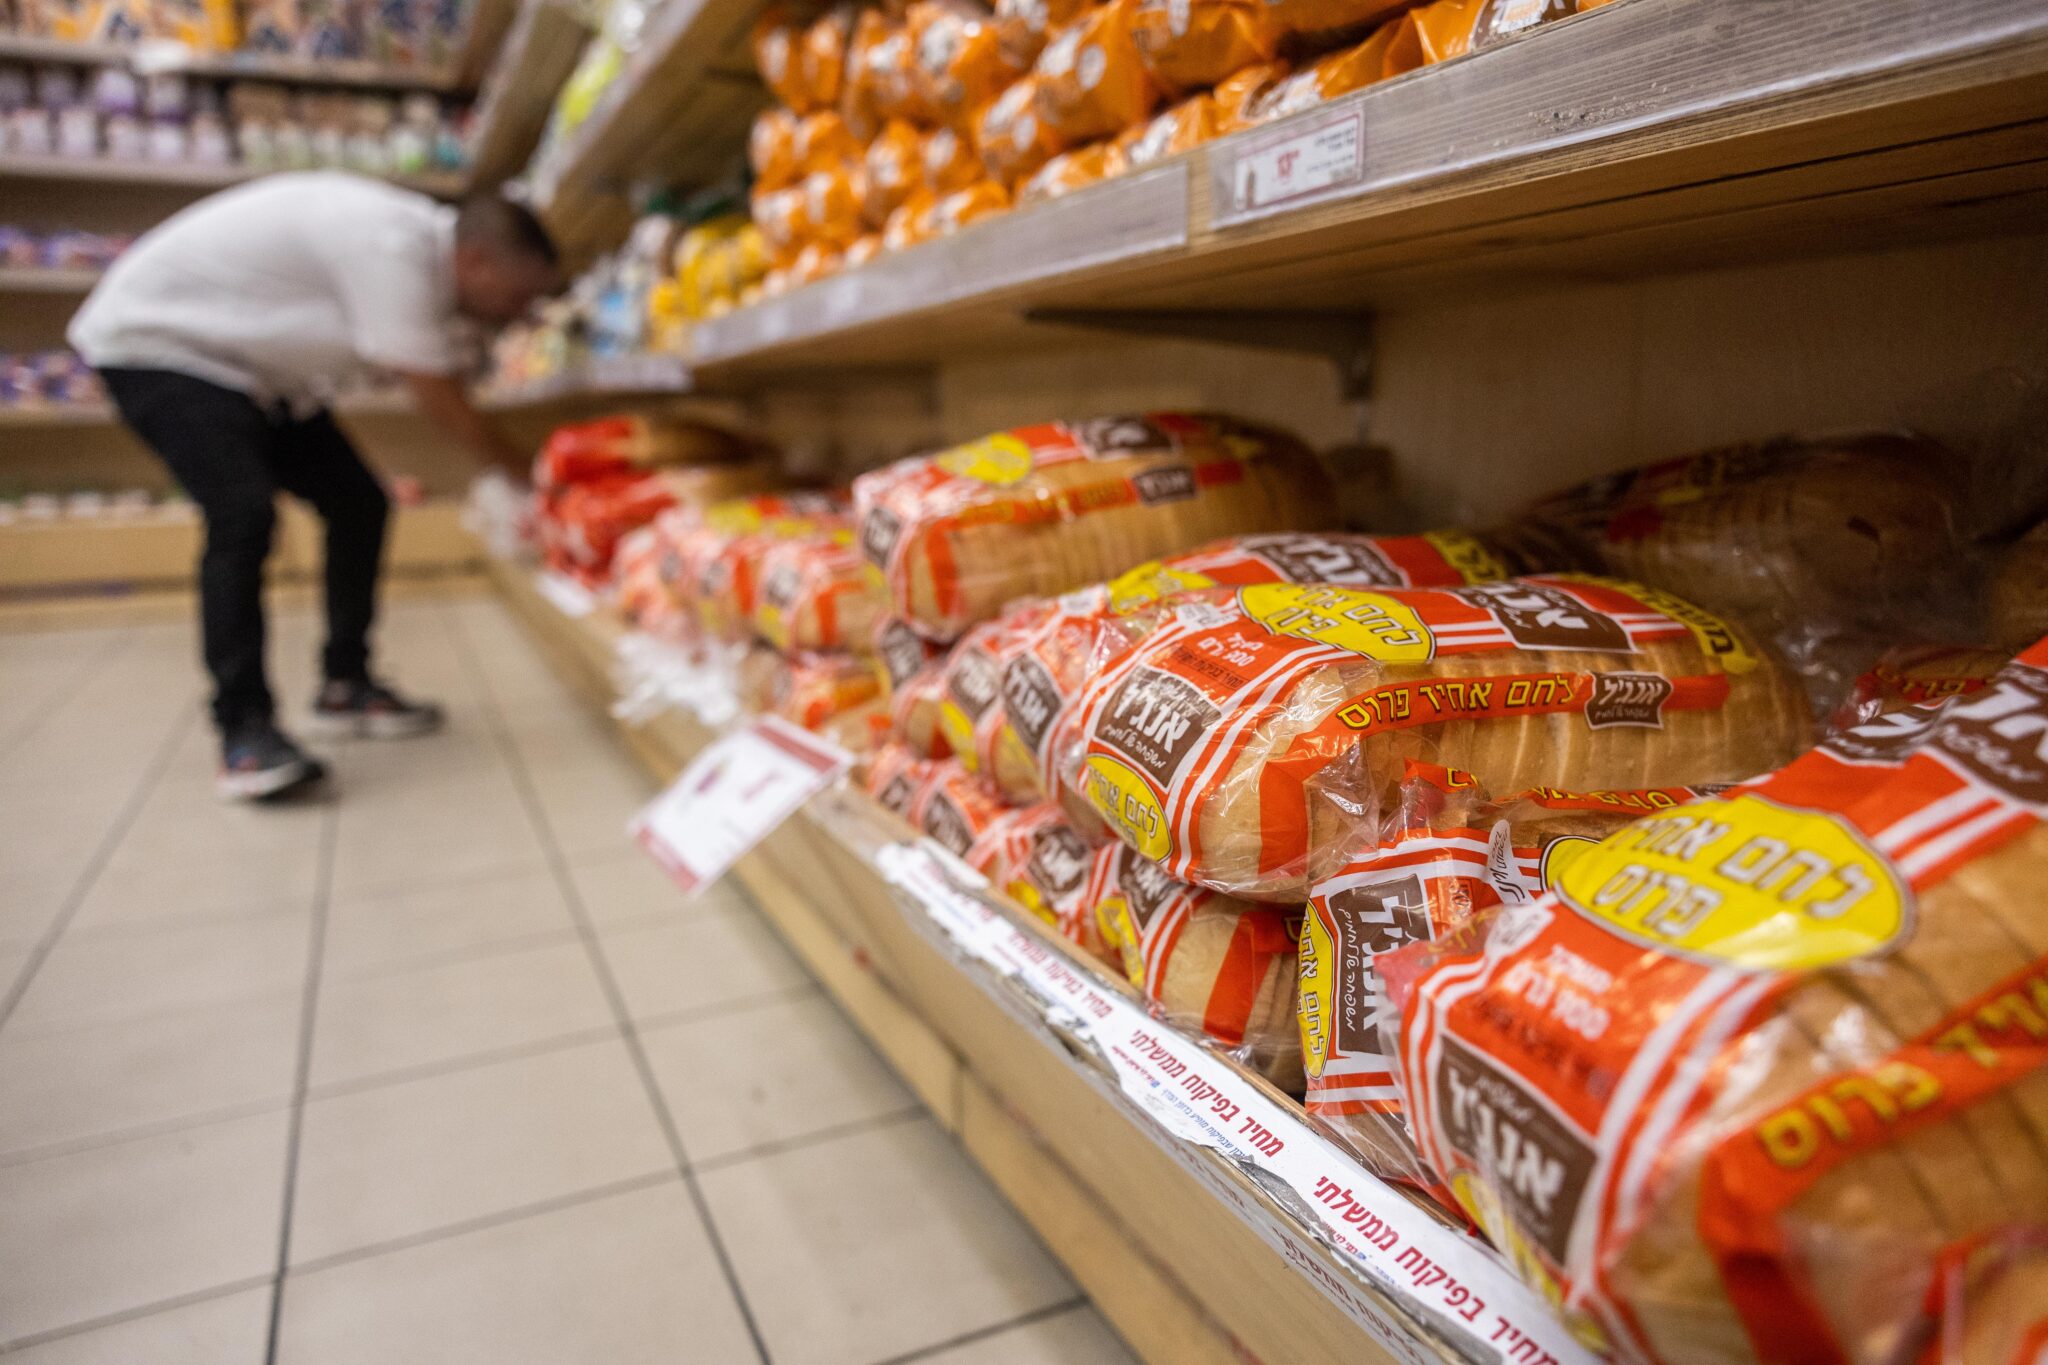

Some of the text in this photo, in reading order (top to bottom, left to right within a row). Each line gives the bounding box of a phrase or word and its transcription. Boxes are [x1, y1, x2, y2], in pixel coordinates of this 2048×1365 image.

[1342, 603, 1423, 646] לחם
[1336, 674, 1575, 730] לחם אחיד פרוס
[1125, 793, 1160, 839] לחם
[1593, 862, 1726, 940] פרוס
[1715, 835, 1878, 921] לחם
[1302, 990, 1325, 1056] לחם
[1343, 971, 1358, 1032] משפחה
[1128, 1027, 1188, 1078] ממשלתי
[1181, 1072, 1242, 1124] בפיקוח
[1756, 1060, 1941, 1170] פרוס
[1238, 1115, 1287, 1160] מחיר
[1313, 1175, 1401, 1252] ממשלתי
[1394, 1246, 1487, 1323] בפיקוח
